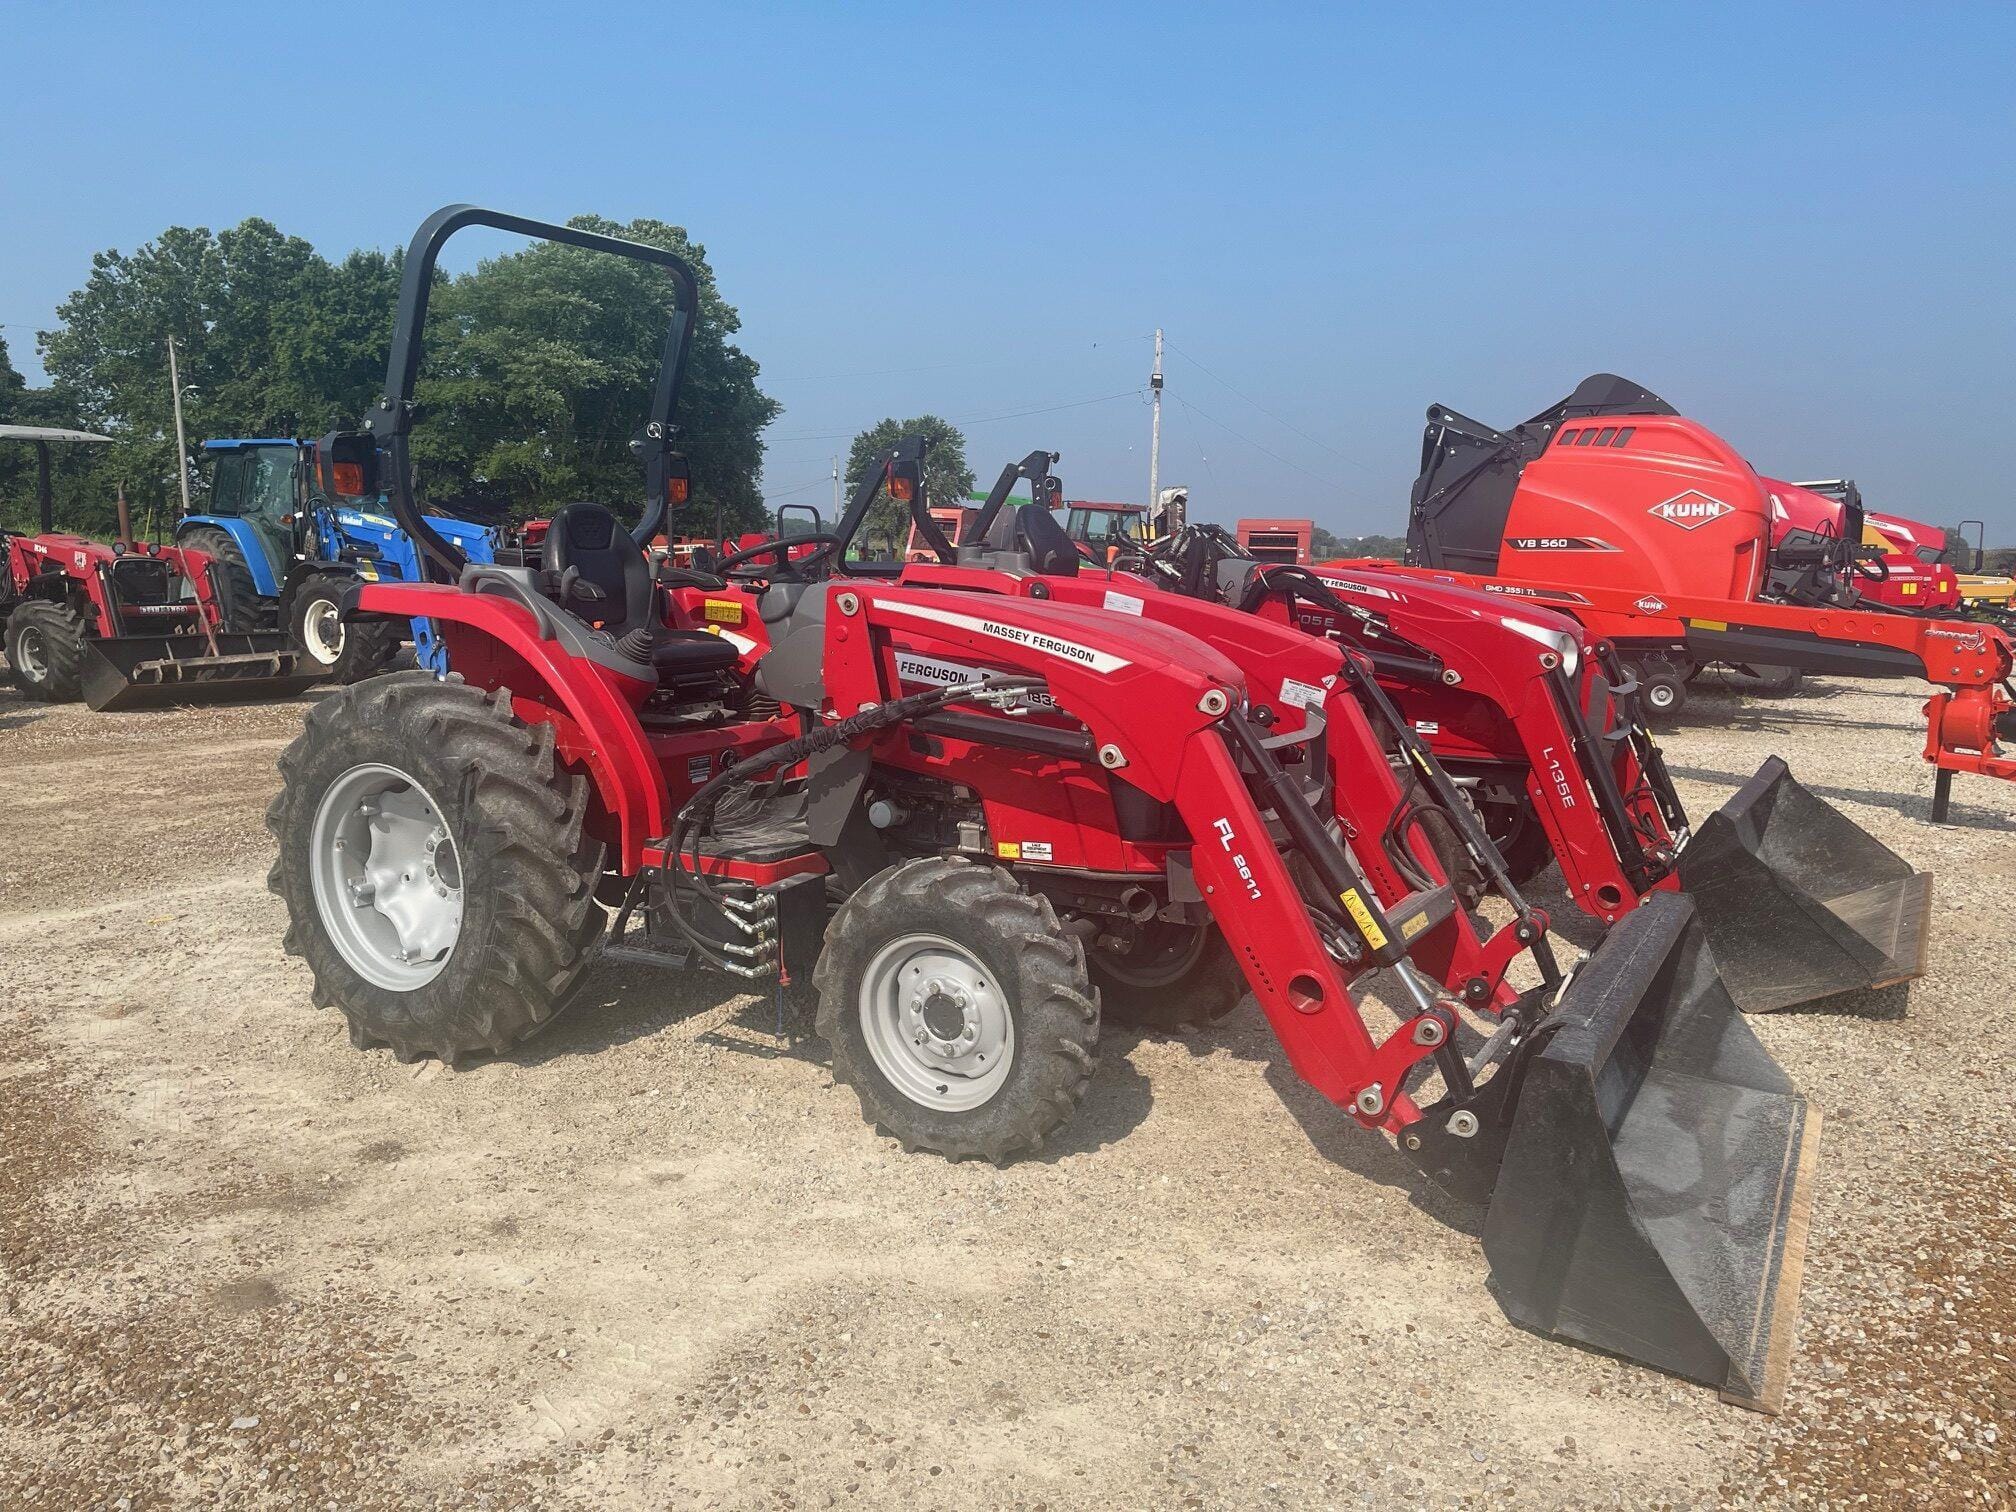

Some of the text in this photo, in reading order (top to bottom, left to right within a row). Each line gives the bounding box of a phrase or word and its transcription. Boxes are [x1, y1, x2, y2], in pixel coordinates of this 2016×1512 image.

[1662, 502, 1720, 517] KUHN
[1517, 539, 1568, 548] VB 560
[1330, 579, 1368, 593] FERGUSON
[1526, 588, 1537, 597] TL
[1638, 601, 1663, 610] KUHN
[982, 622, 1095, 663] MASSEY FERGUSON
[900, 661, 969, 684] FERGUSON
[1542, 746, 1576, 809] L135E
[1212, 817, 1262, 900] FL 2611
